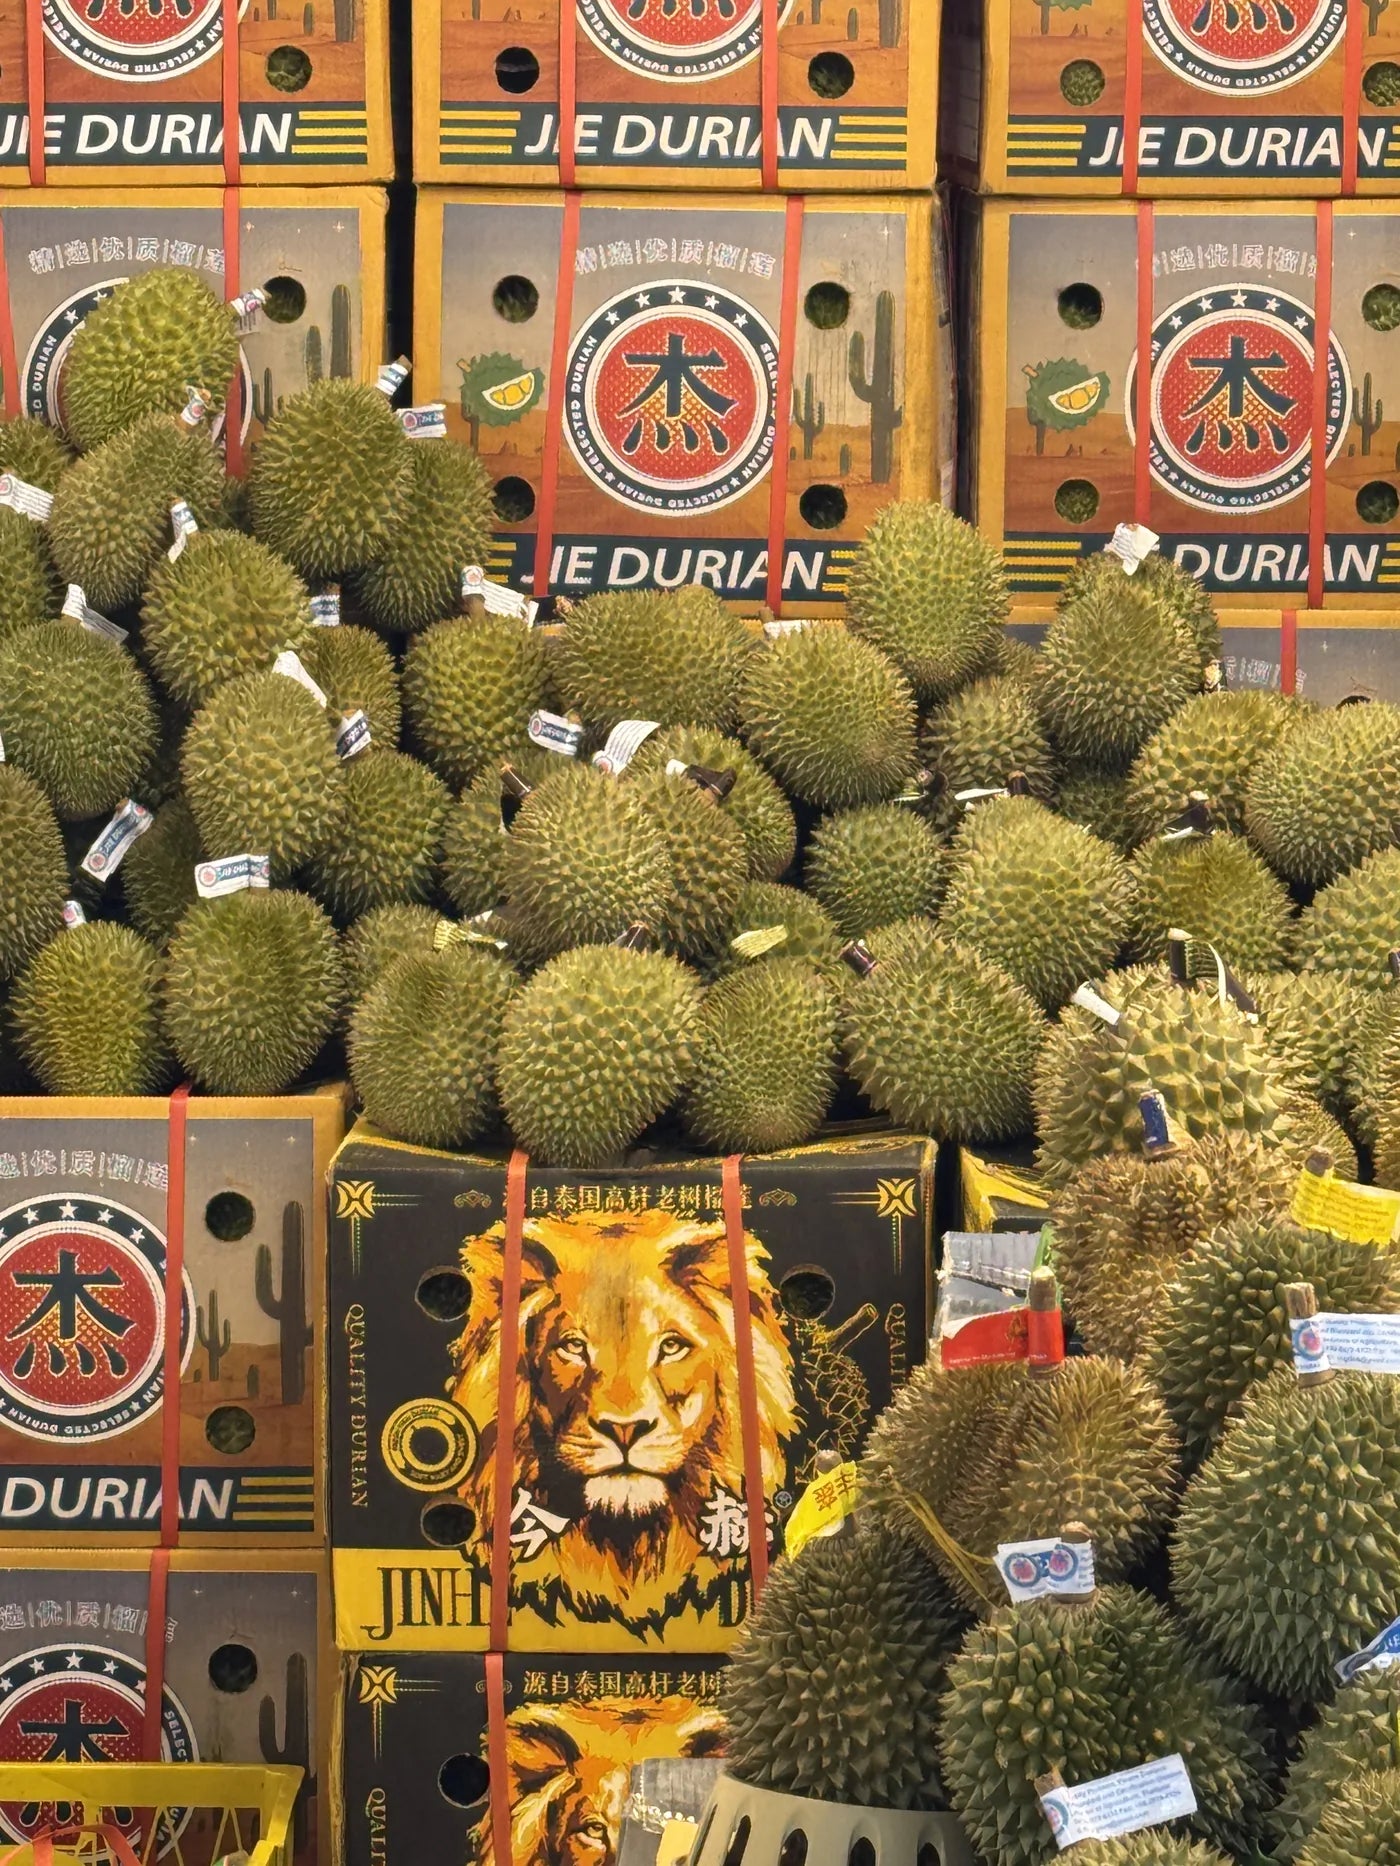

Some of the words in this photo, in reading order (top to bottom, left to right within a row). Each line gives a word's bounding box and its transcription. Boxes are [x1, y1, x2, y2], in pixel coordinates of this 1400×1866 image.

[1306, 3, 1343, 57] DURIAN
[82, 47, 128, 71] DURIAN
[134, 47, 196, 72] SELECTED
[621, 47, 668, 71] DURIAN
[674, 50, 737, 73] SELECTED
[1184, 61, 1230, 86] DURIAN
[1235, 62, 1296, 86] SELECTED
[76, 114, 292, 154] DURIAN
[612, 115, 832, 157] DURIAN
[1174, 126, 1386, 167] DURIAN
[32, 333, 57, 391] DURIAN
[570, 334, 598, 392] DURIAN
[570, 399, 606, 473] SELECTED
[741, 425, 777, 479] DURIAN
[616, 480, 662, 505] DURIAN
[668, 484, 730, 506] SELECTED
[1179, 479, 1224, 503] DURIAN
[1229, 480, 1290, 504] SELECTED
[520, 546, 597, 585] IE
[607, 547, 824, 590] DURIAN
[1174, 543, 1380, 582] DURIAN
[344, 1303, 367, 1408] QUALITY
[7, 1406, 57, 1433] DURIAN
[64, 1408, 130, 1434] SELECTED
[350, 1414, 368, 1509] DURIAN
[1, 1477, 234, 1519] DURIAN
